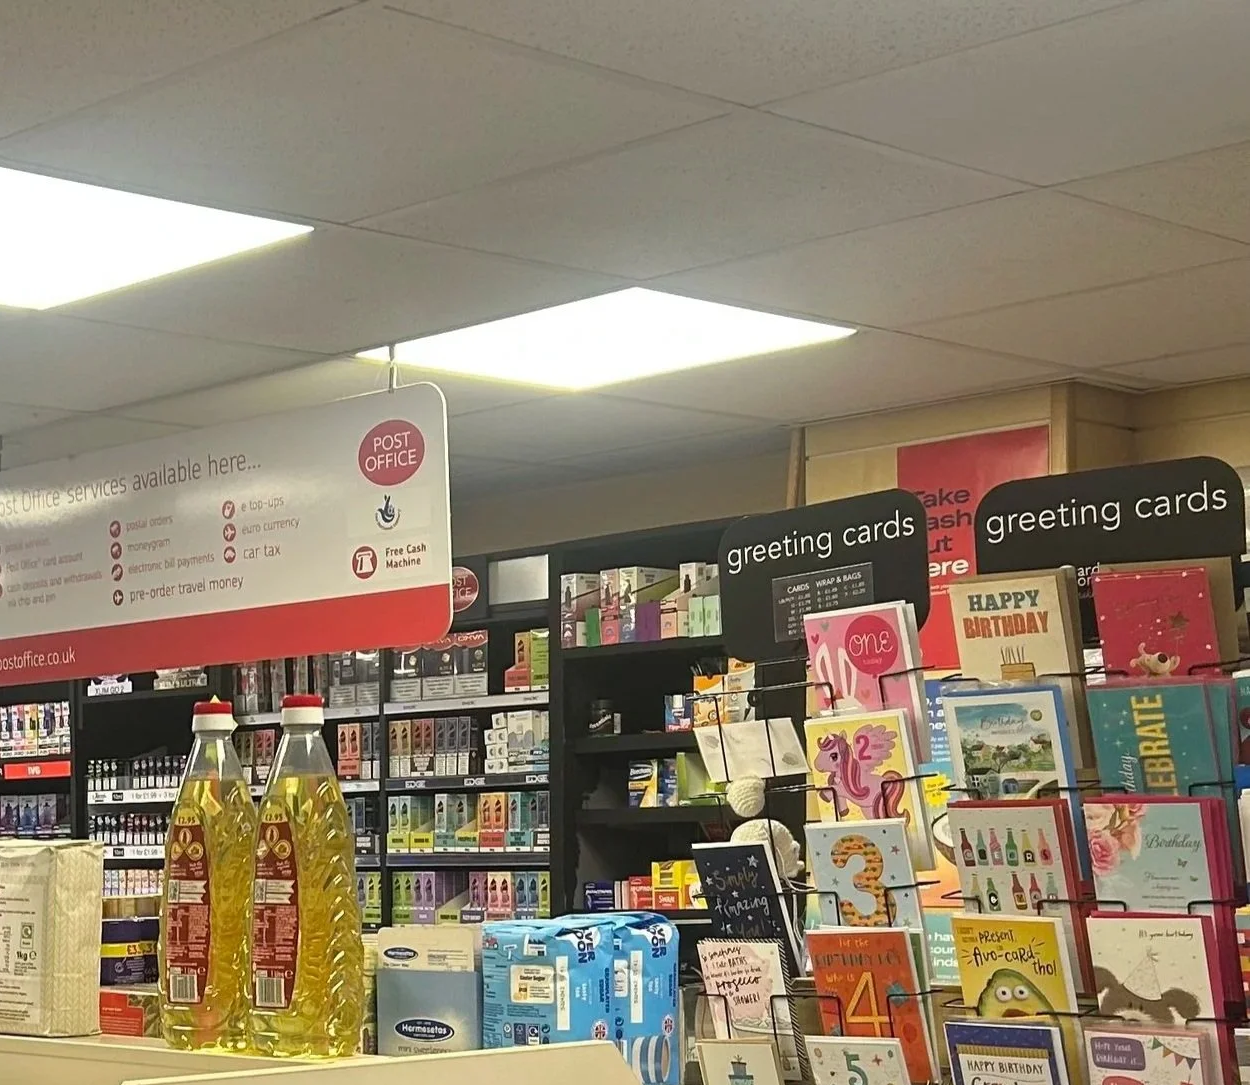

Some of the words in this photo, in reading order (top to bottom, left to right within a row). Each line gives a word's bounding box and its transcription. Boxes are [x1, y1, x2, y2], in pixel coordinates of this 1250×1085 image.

[372, 432, 411, 451] POST
[365, 450, 417, 473] OFFICE
[67, 476, 127, 505] services
[133, 460, 202, 492] available
[208, 452, 262, 478] here...
[928, 509, 972, 530] ash
[986, 498, 1121, 545] greeting
[1134, 481, 1228, 521] cards
[265, 516, 300, 531] currency
[242, 547, 262, 560] car
[264, 543, 282, 557] tax
[385, 545, 405, 559] Free
[405, 542, 426, 556] Cash
[727, 525, 833, 574] greeting
[843, 509, 916, 546] cards
[385, 555, 421, 569] Machine
[929, 558, 969, 577] ere
[129, 585, 175, 604] pre-order
[178, 578, 206, 596] travel
[208, 575, 245, 594] money
[786, 583, 810, 594] CARDS
[815, 577, 835, 588] WRAP
[842, 572, 862, 581] BAGS
[967, 589, 1040, 613] HAPPY
[962, 611, 1050, 640] BIRTHDAY
[855, 735, 872, 762] 2
[1130, 694, 1179, 796] EBRATE
[404, 780, 426, 789] EDGE
[463, 777, 486, 786] EDGE
[525, 774, 549, 784] EDGE
[1145, 832, 1202, 852] Birthday
[830, 834, 898, 927] 3
[1033, 958, 1058, 976] tho!
[845, 972, 889, 1037] 4
[967, 1059, 995, 1072] HAPPY
[998, 1062, 1044, 1075] BIRTHDAY
